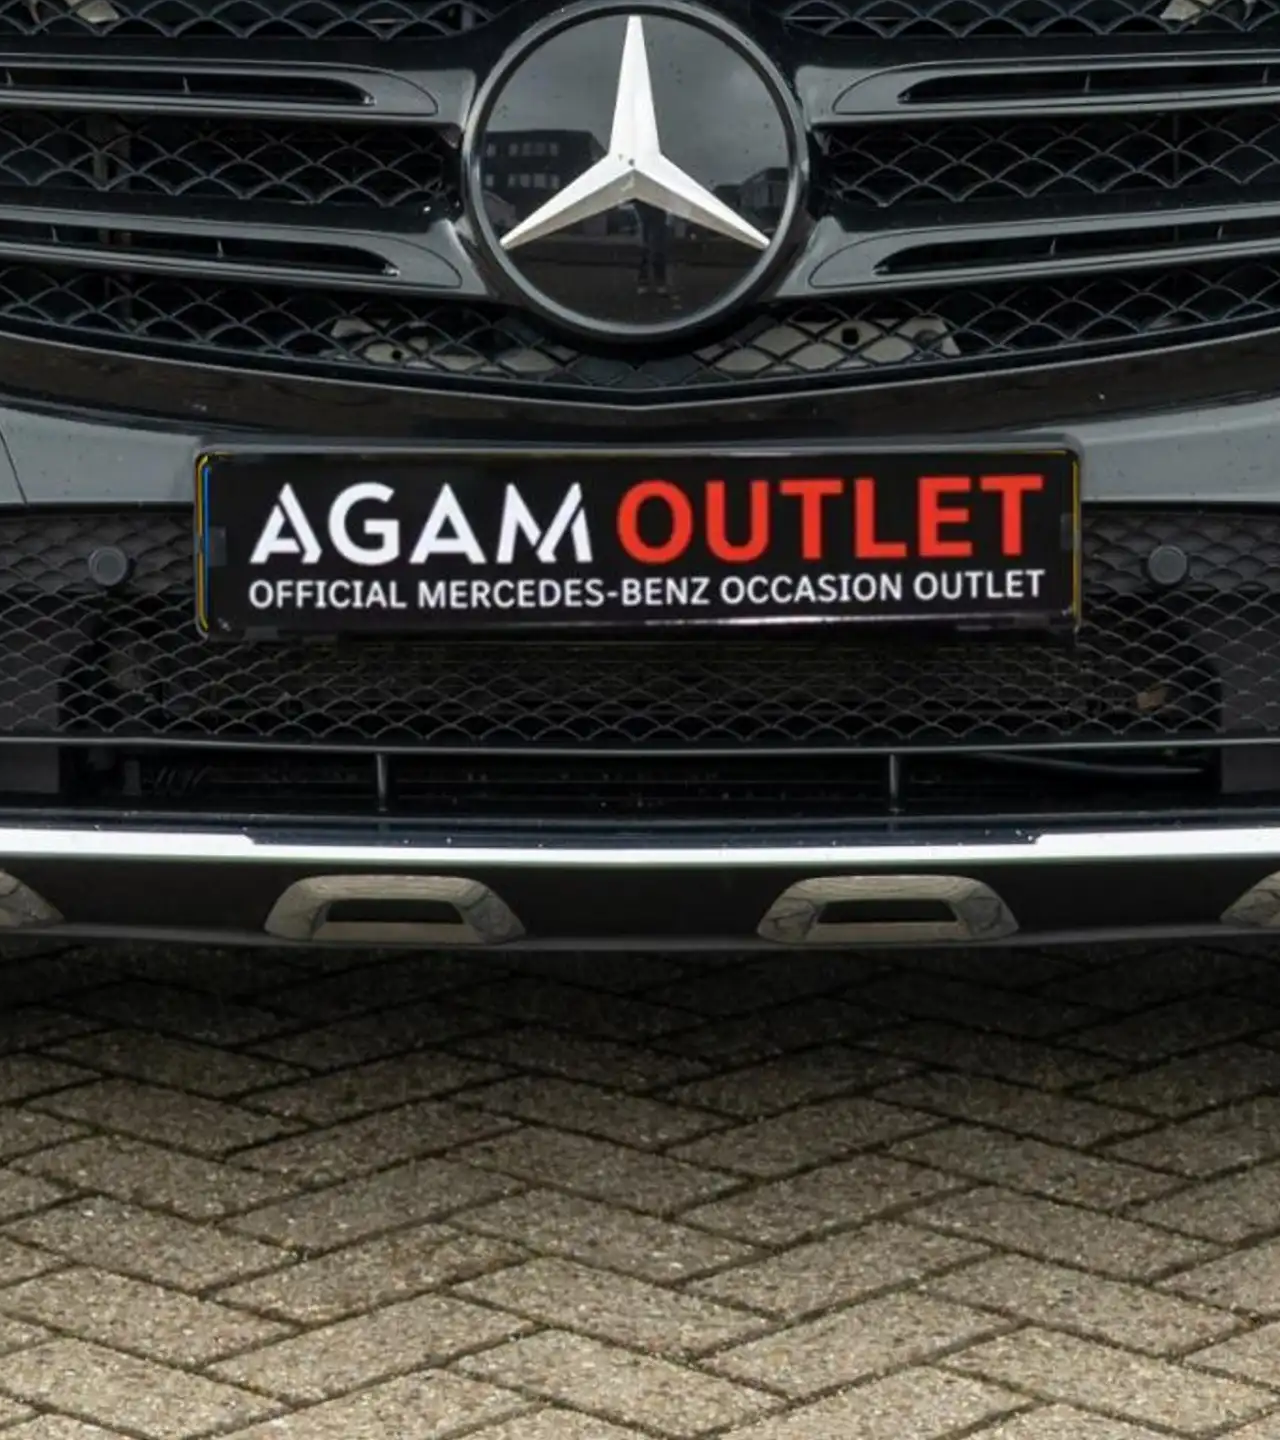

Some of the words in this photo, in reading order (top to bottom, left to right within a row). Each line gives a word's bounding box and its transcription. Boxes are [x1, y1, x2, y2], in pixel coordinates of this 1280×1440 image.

[248, 481, 594, 566] AGAM
[616, 474, 1045, 565] OUTLET
[248, 578, 408, 610] OFFICIAL
[417, 574, 711, 610] MERCEDES-BENZ
[719, 572, 903, 606] OCCASION
[912, 568, 1046, 602] OUTLET
